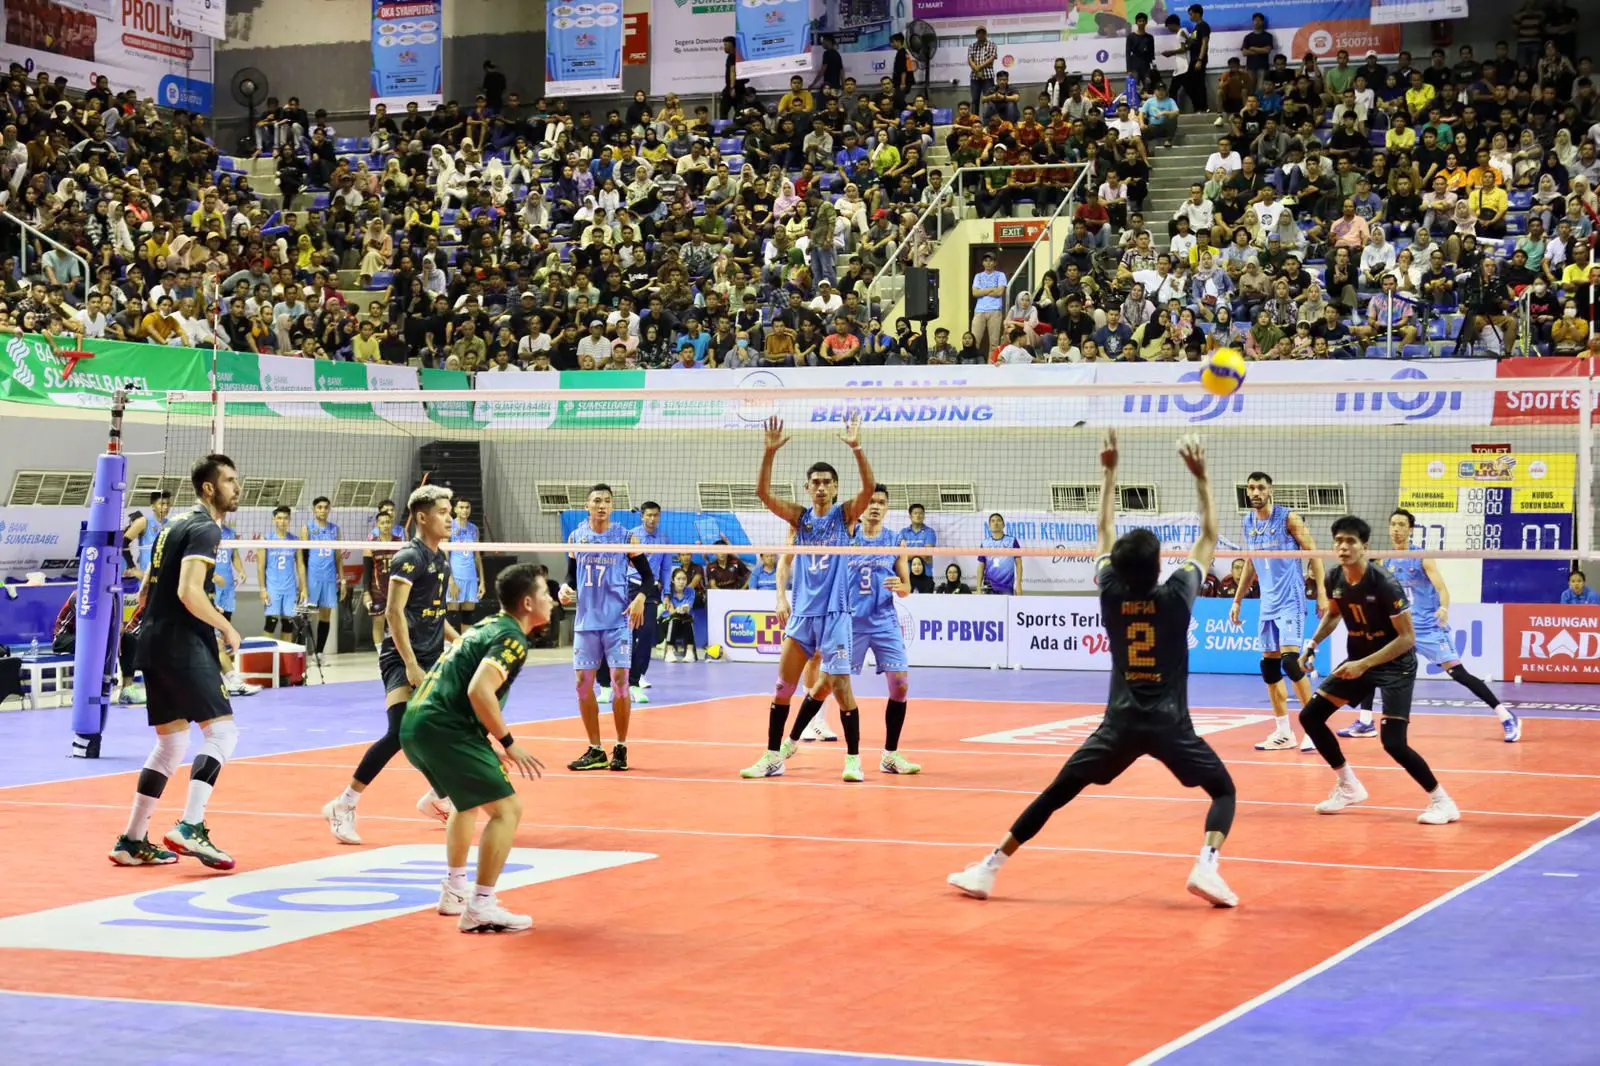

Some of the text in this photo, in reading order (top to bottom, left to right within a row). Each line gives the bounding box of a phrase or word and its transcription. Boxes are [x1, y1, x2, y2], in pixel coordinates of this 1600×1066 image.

[1336, 36, 1381, 48] 1500711
[1002, 227, 1021, 236] EXIT
[1506, 391, 1581, 413] Sports
[4, 534, 60, 545] SUMSELBABEL
[277, 556, 286, 569] 2
[585, 564, 606, 587] 17
[860, 567, 872, 589] 3
[79, 562, 95, 616] Senoh
[1016, 611, 1067, 630] Sports
[1348, 603, 1368, 625] 11
[1529, 616, 1598, 628] TABUNGAN
[920, 620, 1004, 642] PP. PBVSI
[1205, 619, 1247, 634] BANK
[1030, 636, 1059, 650] Ada
[1063, 635, 1078, 650] di
[1127, 622, 1156, 667] 2
[1522, 663, 1578, 673] RENCANA
